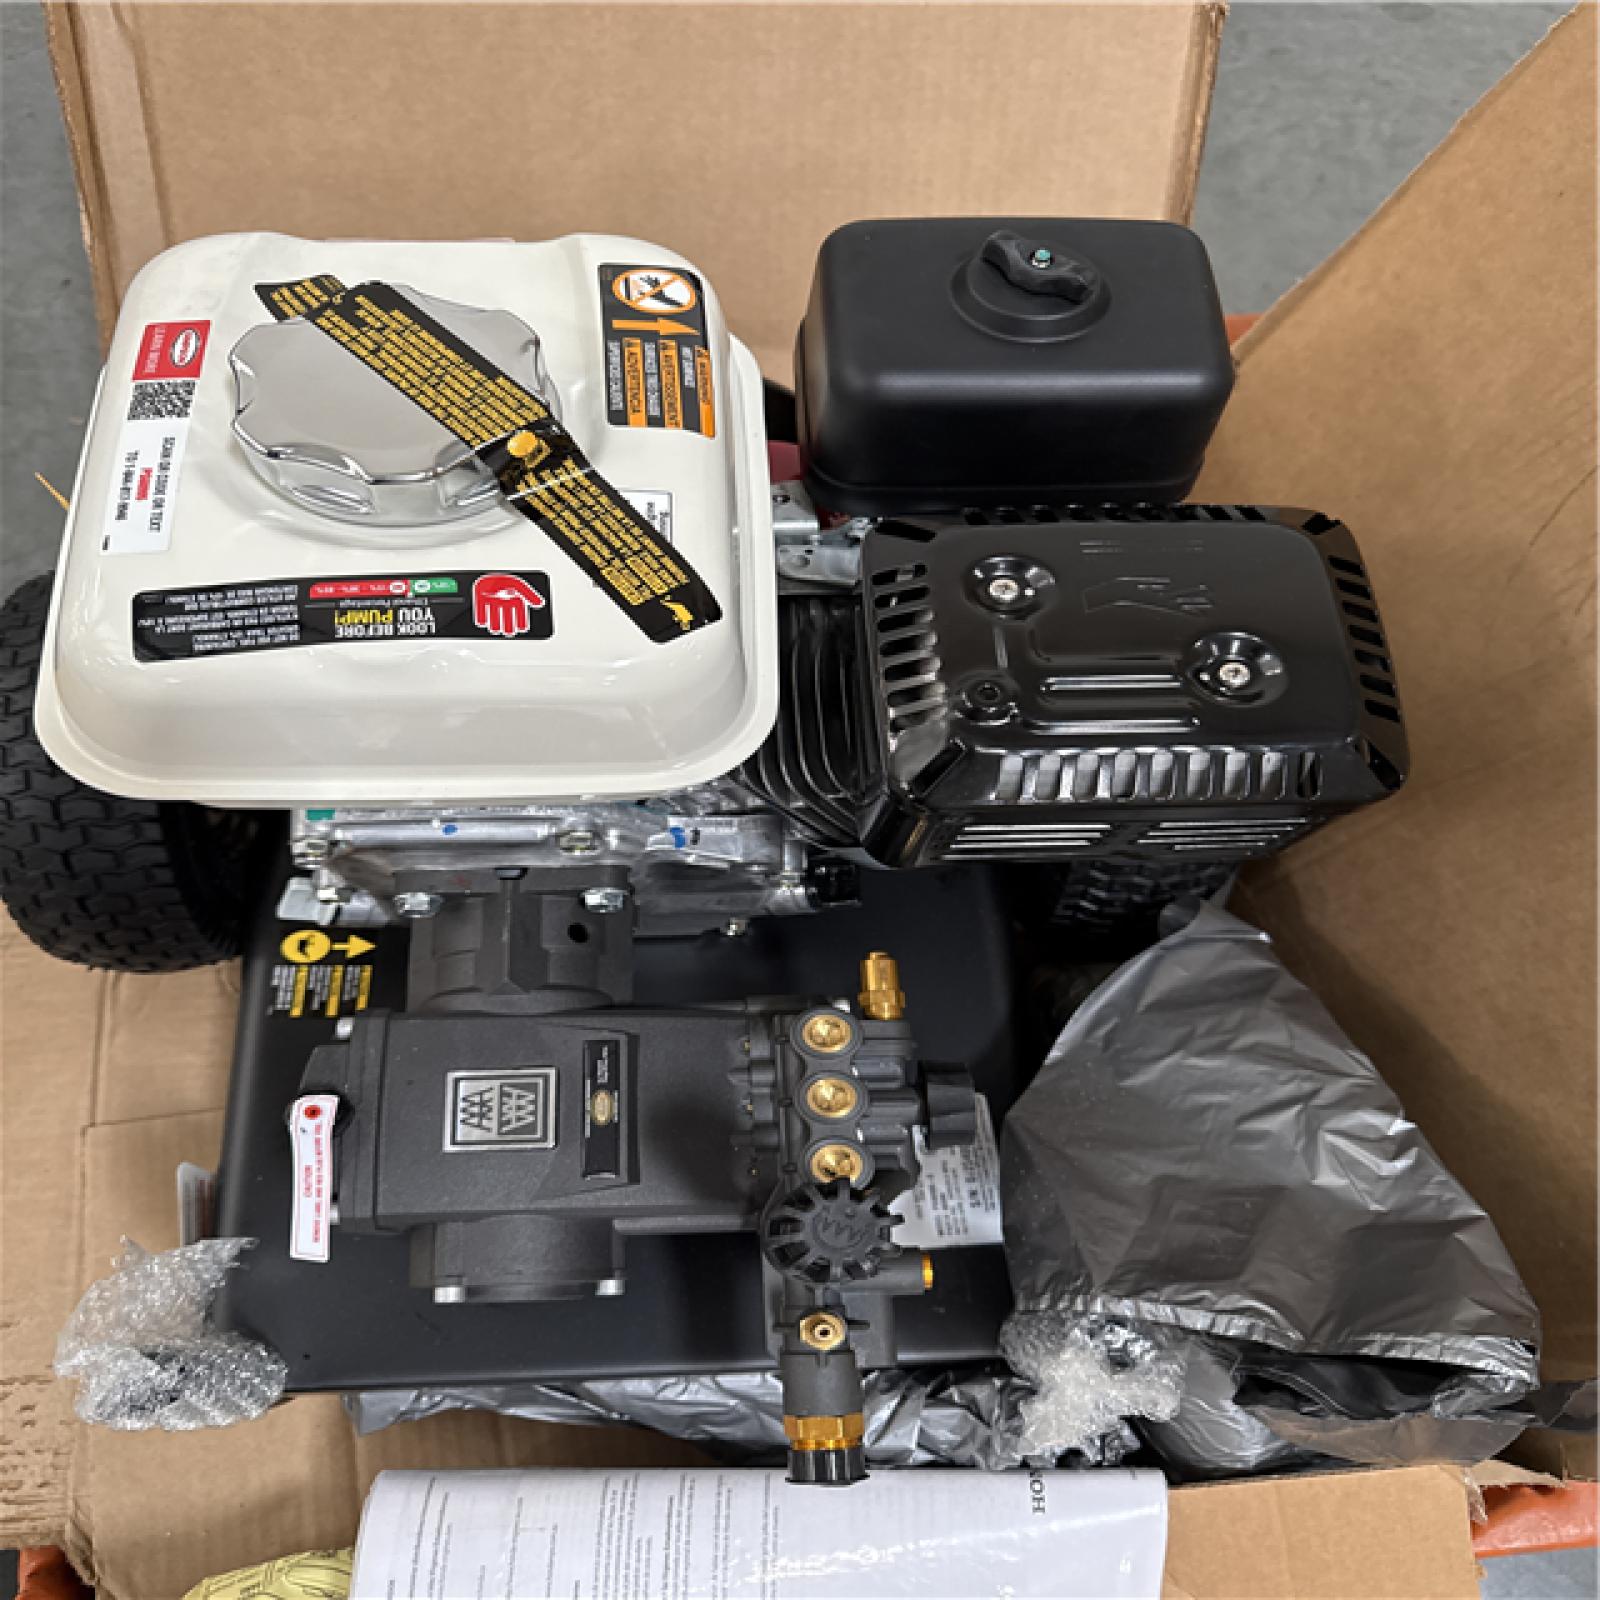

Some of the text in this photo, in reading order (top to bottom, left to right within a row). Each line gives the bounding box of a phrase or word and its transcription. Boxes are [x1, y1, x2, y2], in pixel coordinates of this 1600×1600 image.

[335, 606, 434, 625] YOU PUMP!
[335, 621, 436, 638] LOOK BEFORE
